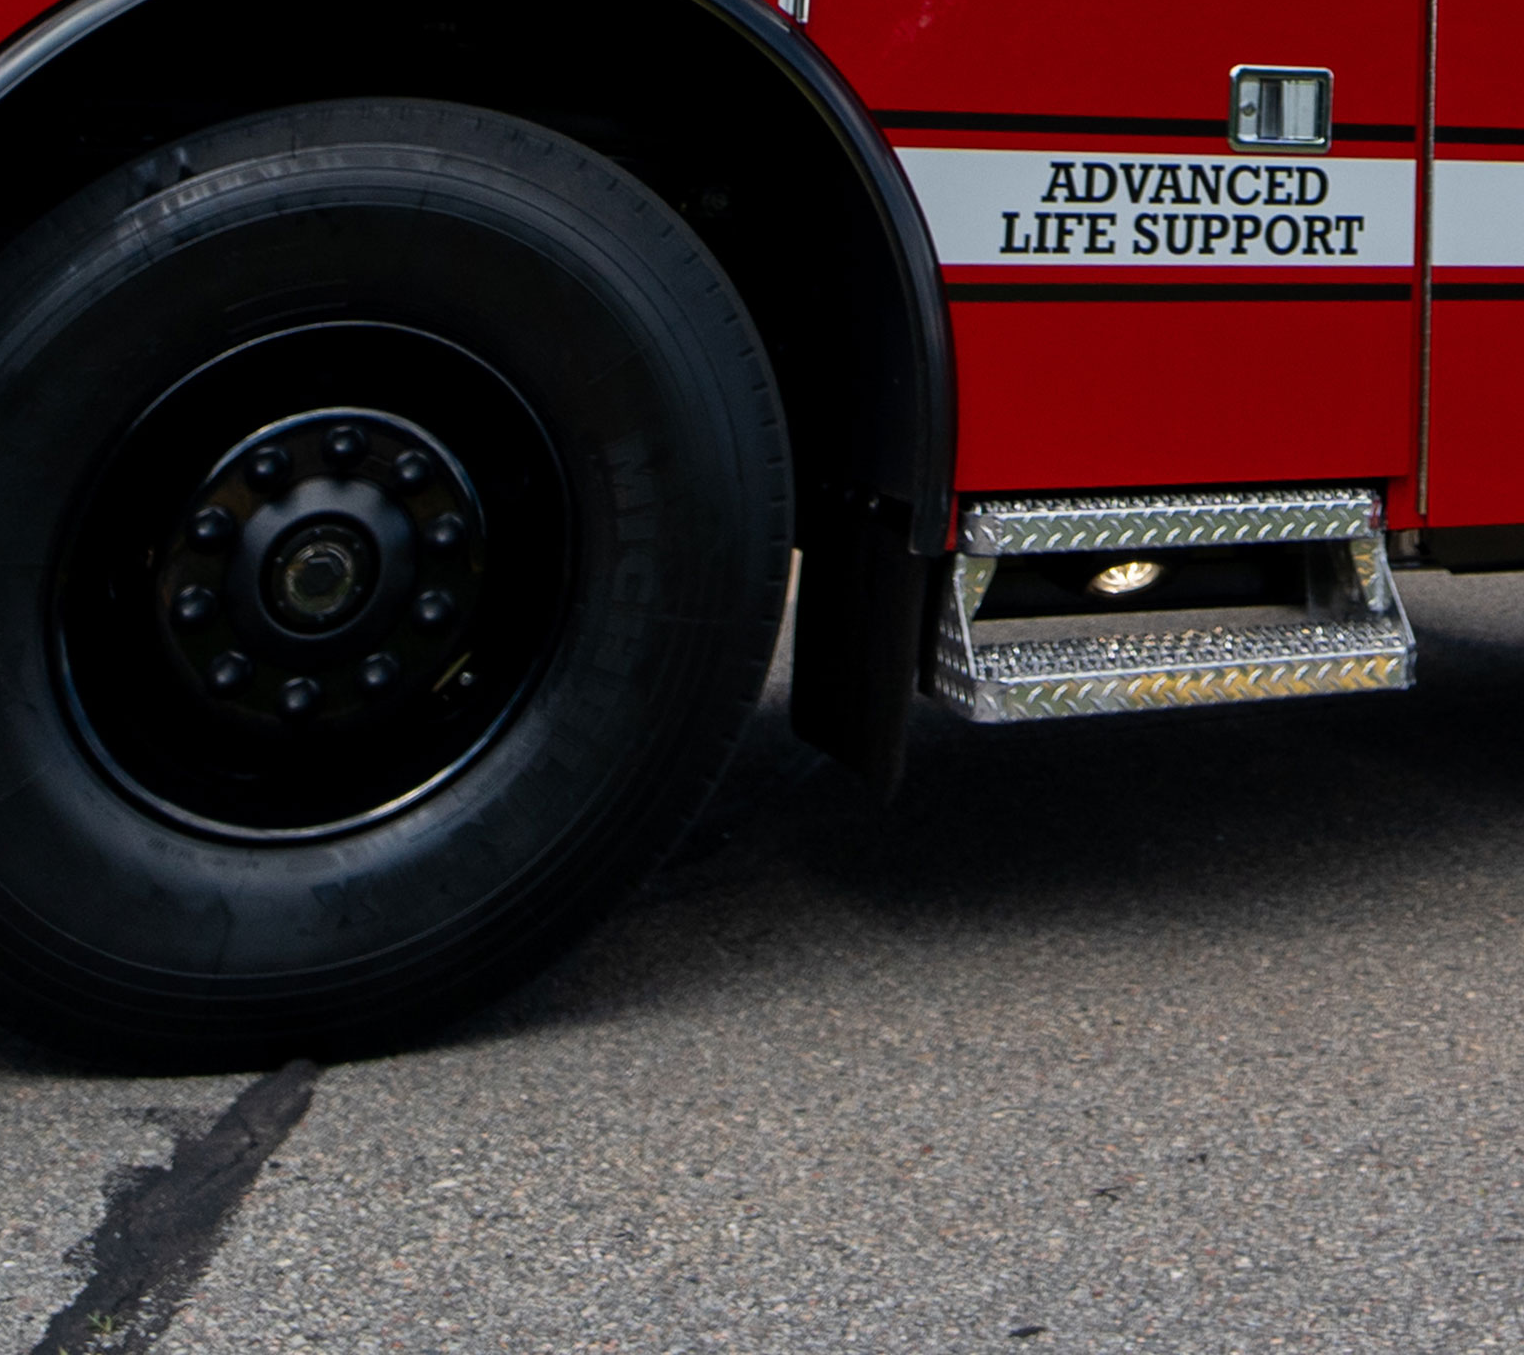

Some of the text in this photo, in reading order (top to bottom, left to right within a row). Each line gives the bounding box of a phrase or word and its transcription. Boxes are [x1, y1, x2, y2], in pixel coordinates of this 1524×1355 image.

[1040, 161, 1329, 206] ADVANCED
[999, 211, 1365, 256] LIFE SUPPORT
